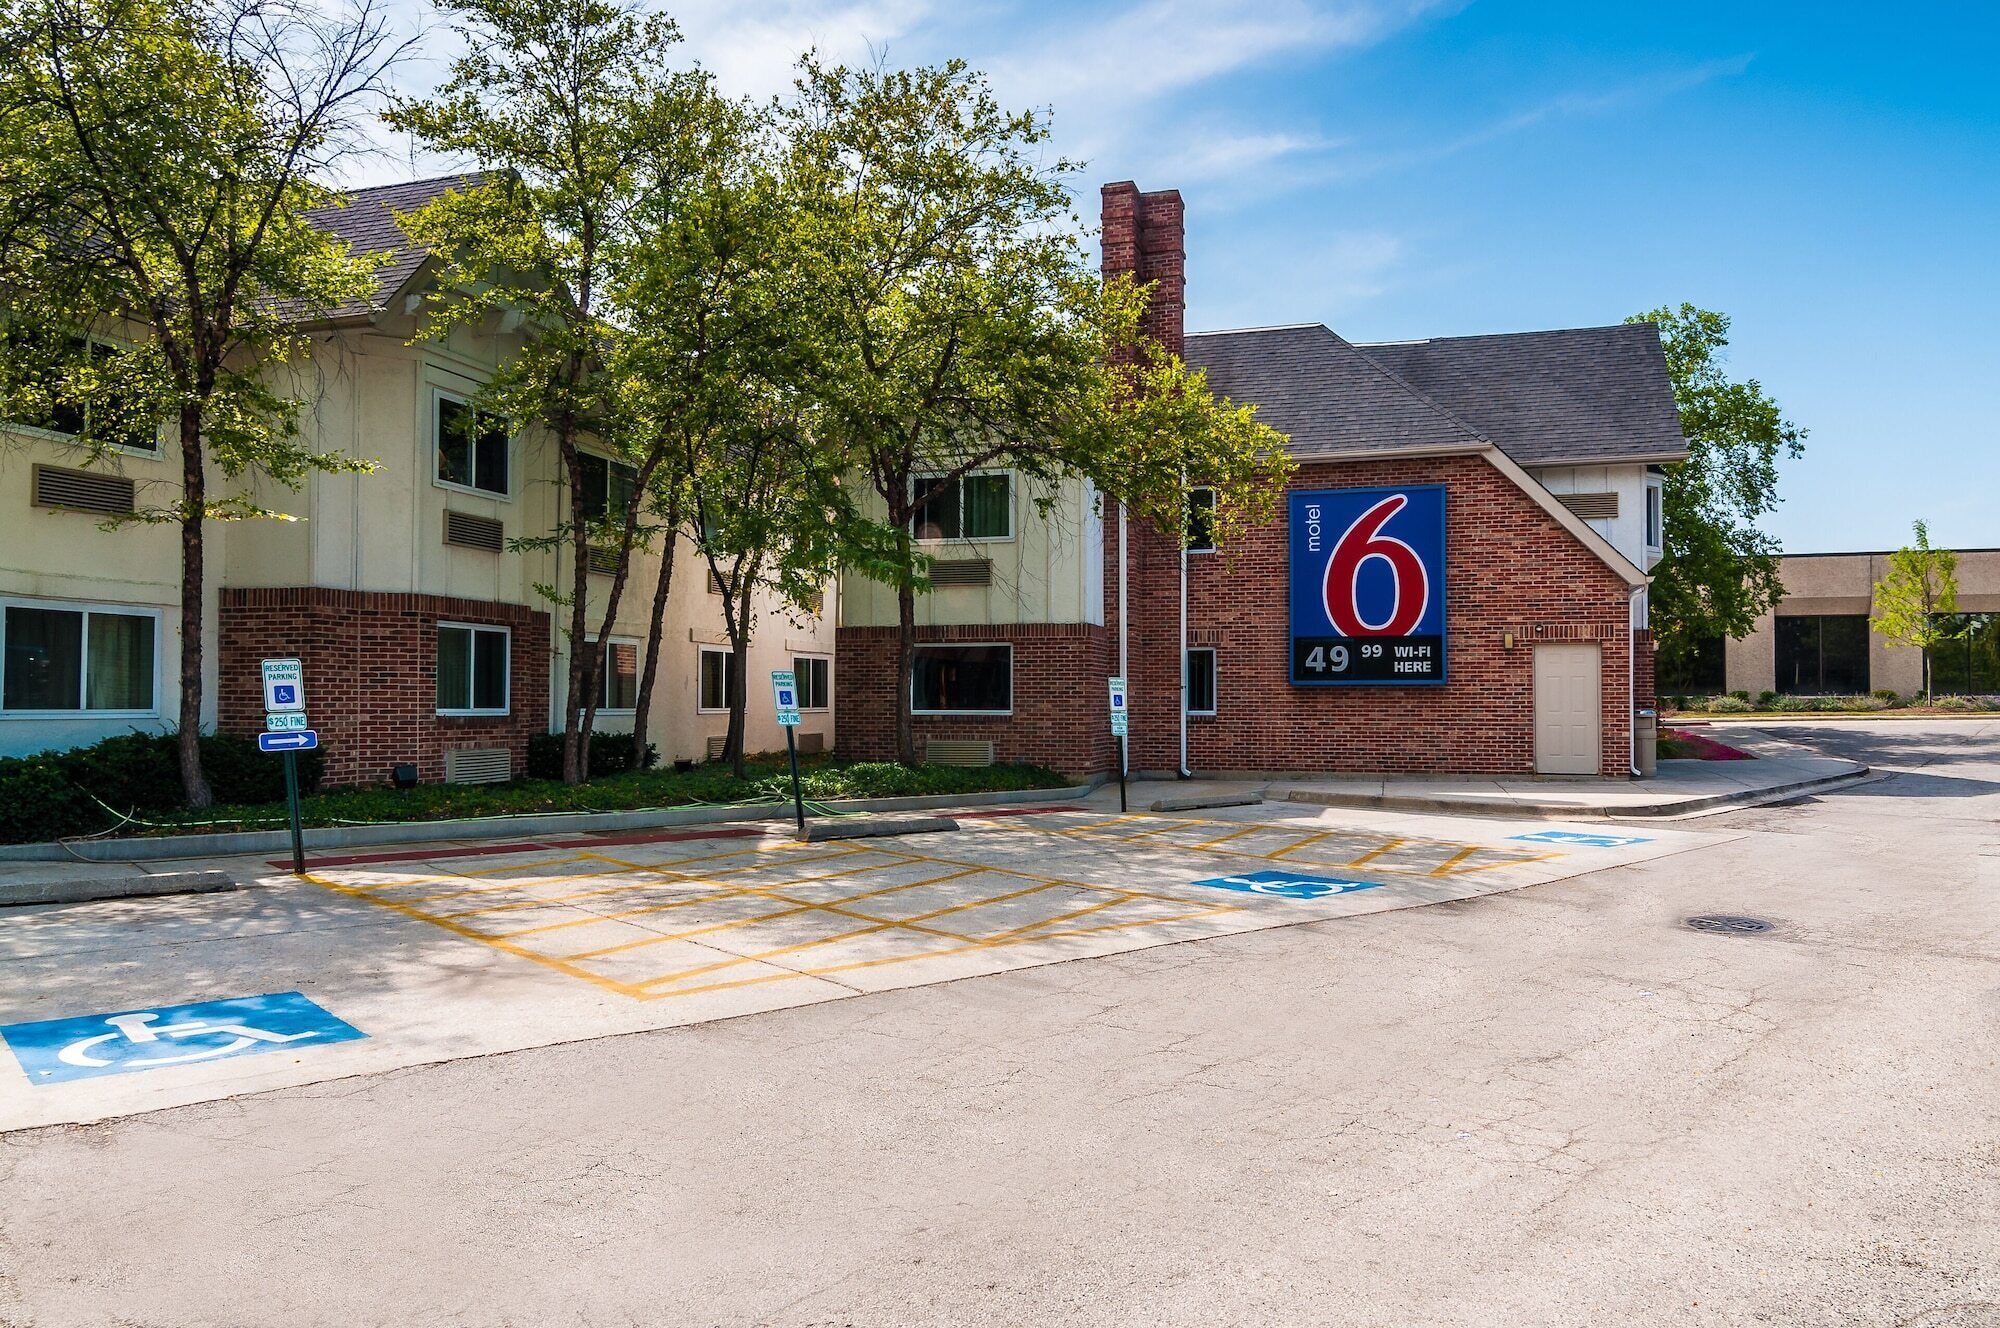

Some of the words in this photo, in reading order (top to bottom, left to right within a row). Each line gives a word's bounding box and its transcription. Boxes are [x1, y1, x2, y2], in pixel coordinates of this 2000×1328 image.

[1304, 504, 1321, 552] motel
[1322, 493, 1430, 637] 6
[1305, 645, 1349, 672] 49
[1361, 644, 1383, 658] 99
[1394, 646, 1431, 658] WI-FI
[265, 664, 299, 672] RESERVED
[1394, 661, 1432, 673] HERE
[268, 673, 297, 681] PARKING
[290, 716, 306, 727] FINE
